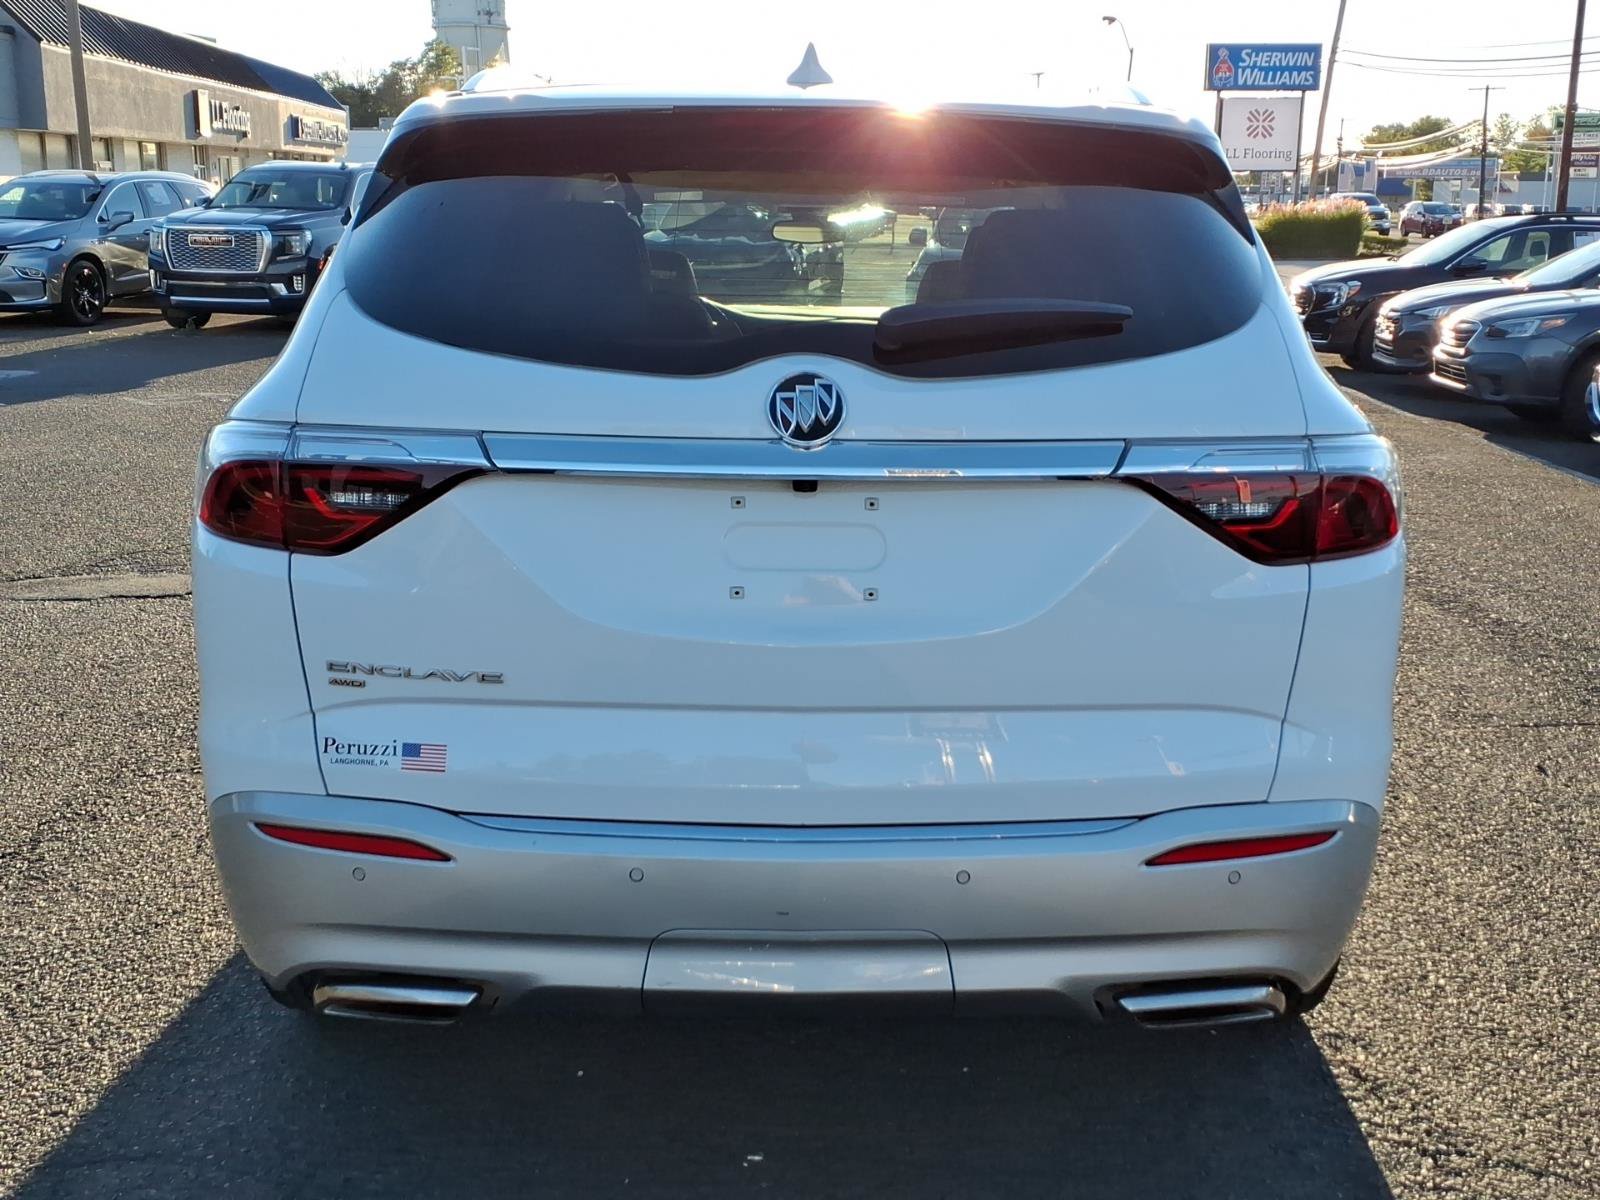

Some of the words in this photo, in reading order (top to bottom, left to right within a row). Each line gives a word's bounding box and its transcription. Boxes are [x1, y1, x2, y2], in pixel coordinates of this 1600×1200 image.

[1239, 49, 1316, 67] SHERWIN
[1237, 67, 1315, 86] WILLIAMS
[1226, 148, 1240, 159] LL
[1243, 147, 1292, 161] Flooring
[327, 660, 504, 684] ENCLAVE
[328, 677, 365, 688] AWD
[323, 736, 398, 756] Peruzzi
[330, 757, 378, 767] LANGHORNE,
[379, 759, 390, 767] PA
